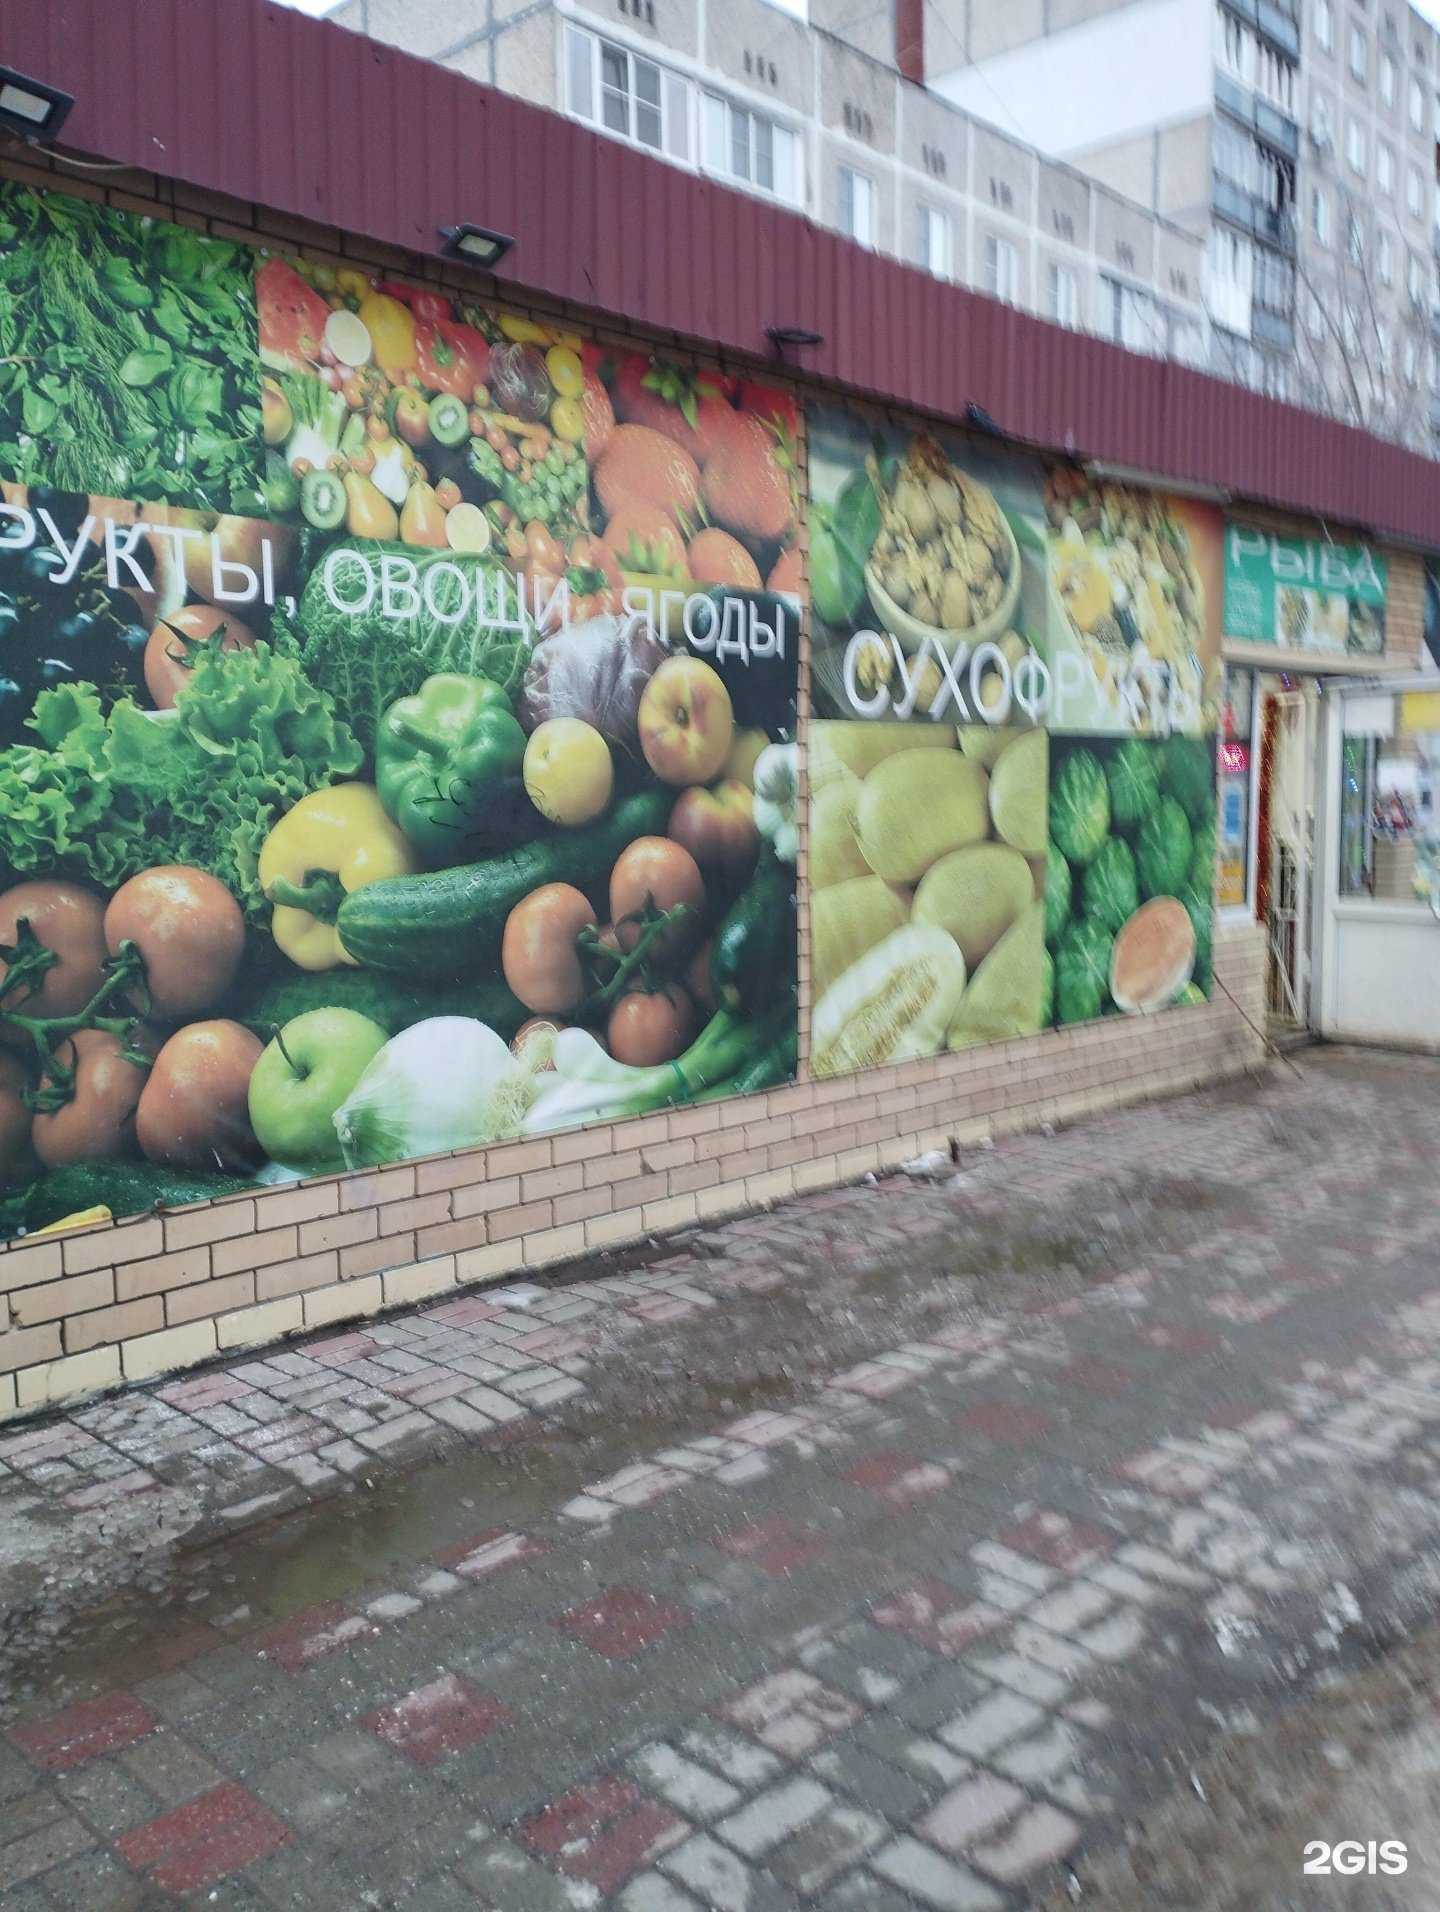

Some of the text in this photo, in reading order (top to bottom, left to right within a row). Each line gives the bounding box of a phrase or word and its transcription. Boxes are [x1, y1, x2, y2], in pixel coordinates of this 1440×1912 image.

[323, 548, 570, 645] ОВОЩИ
[621, 585, 786, 668] ЯГОДЫ
[1230, 525, 1386, 598] РЫБА
